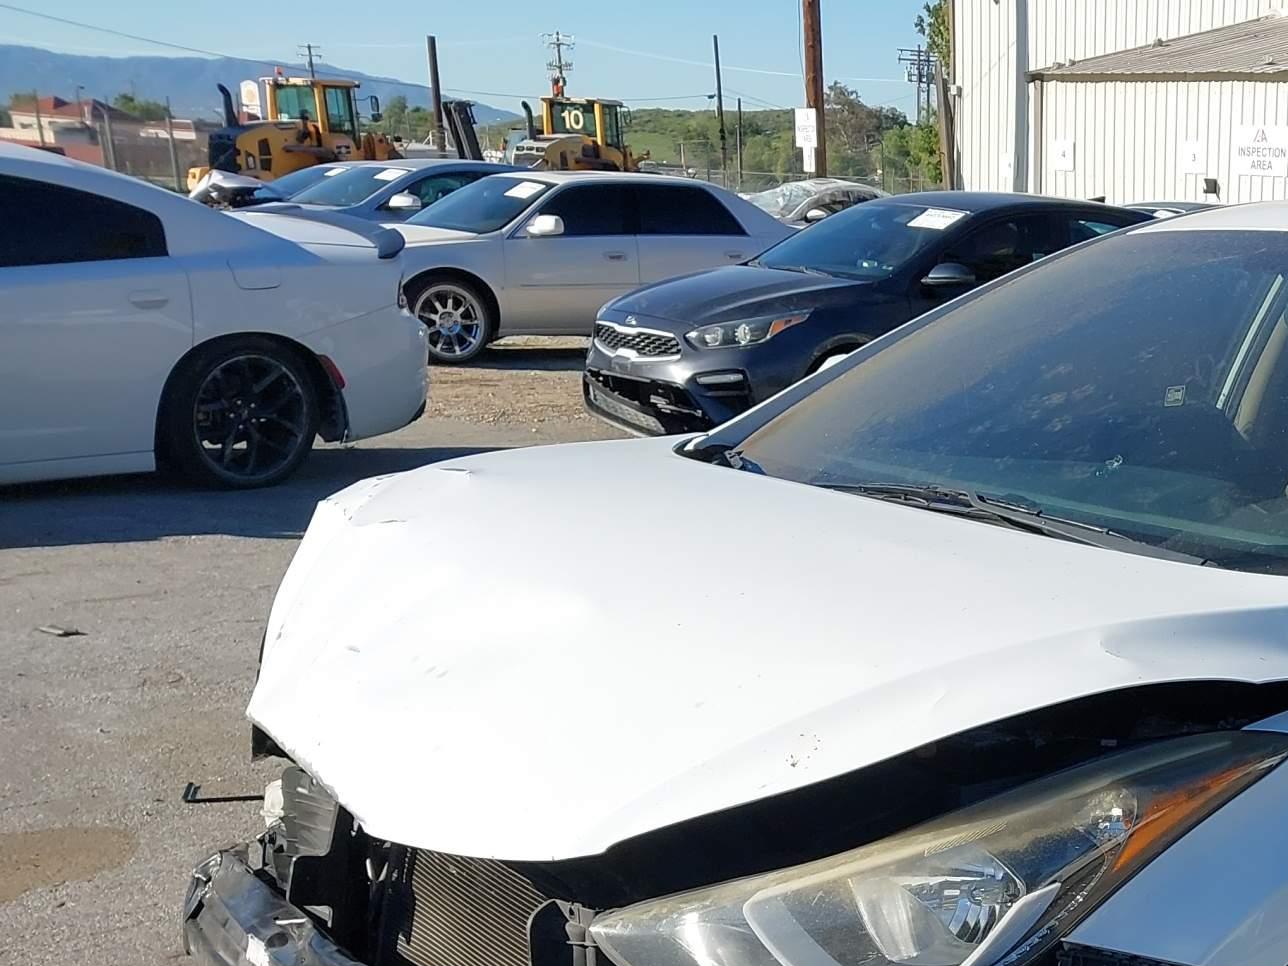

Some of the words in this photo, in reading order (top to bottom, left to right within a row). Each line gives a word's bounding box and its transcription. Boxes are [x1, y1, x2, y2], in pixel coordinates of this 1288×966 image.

[561, 110, 584, 129] 10
[1238, 147, 1287, 158] INSPECTION
[1251, 160, 1273, 170] AREA
